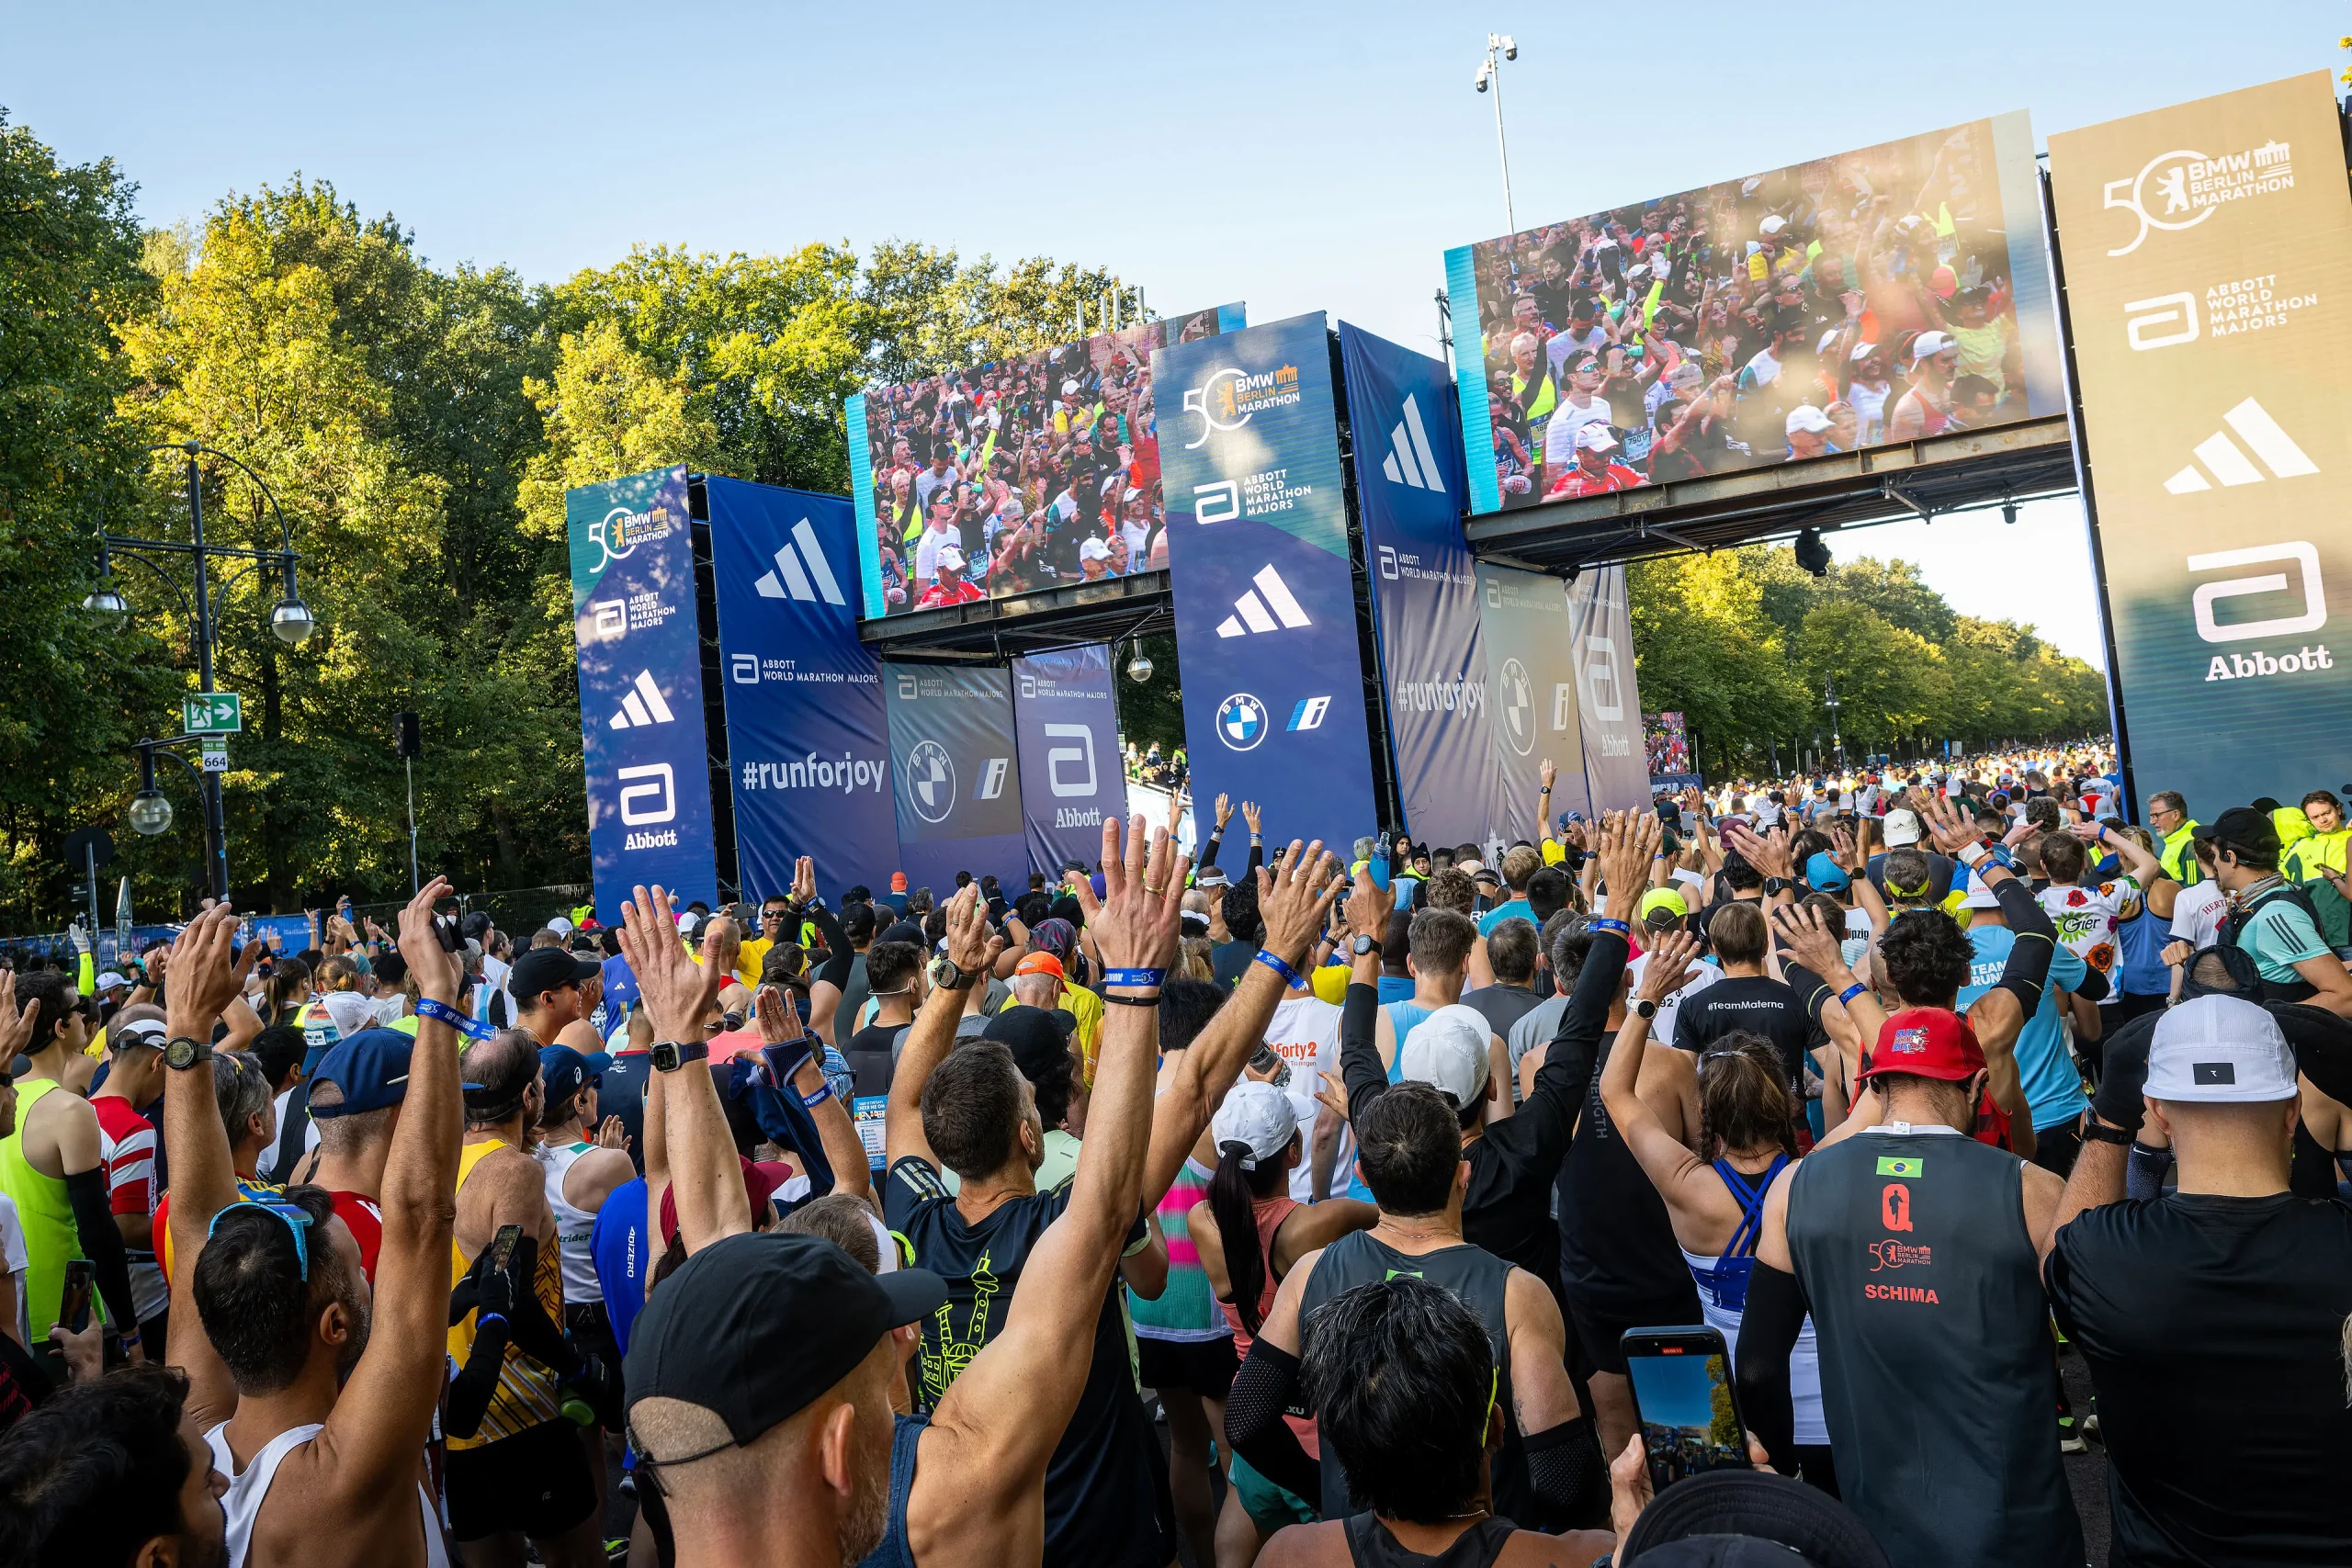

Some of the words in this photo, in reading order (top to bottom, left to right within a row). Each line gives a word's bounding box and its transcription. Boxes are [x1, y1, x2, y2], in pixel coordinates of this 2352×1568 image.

[2188, 150, 2250, 182] BMW
[2190, 170, 2255, 194] BERLIN
[2191, 175, 2294, 209] MARATHON
[2206, 274, 2277, 299] ABBOTT
[2206, 288, 2272, 310] WORLD
[2209, 293, 2318, 325] MARATHON
[2211, 312, 2288, 337] MAJORS
[1235, 371, 1274, 393] BMW
[1237, 386, 1276, 403] BERLIN
[1238, 392, 1300, 414] MARATHON
[1243, 468, 1287, 486] ABBOTT
[1244, 479, 1284, 496] WORLD
[1246, 485, 1312, 506] MARATHON
[1247, 499, 1294, 516] MAJORS
[625, 512, 651, 528] BMW
[626, 525, 652, 536] BERLIN
[626, 529, 669, 546] MARATHON
[1399, 553, 1420, 566] ABBOTT
[1400, 566, 1420, 579] WORLD
[1421, 570, 1452, 583] MARATHON
[1452, 573, 1473, 586] MAJORS
[629, 592, 659, 605] ABBOTT
[629, 602, 658, 613] WORLD
[630, 605, 676, 621] MARATHON
[631, 617, 663, 630] MAJORS
[763, 660, 796, 670] ABBOTT
[2205, 644, 2334, 682] Abbott
[763, 671, 794, 682] WORLD
[797, 672, 844, 682] MARATHON
[847, 674, 878, 683] MAJORS
[920, 679, 944, 687] ABBOTT
[1037, 680, 1057, 688] ABBOTT
[920, 689, 943, 697] WORLD
[944, 689, 978, 698] MARATHON
[979, 690, 1003, 698] MAJORS
[1037, 689, 1056, 697] WORLD
[1056, 690, 1085, 699] MARATHON
[1398, 671, 1486, 719] #runforjoy
[1222, 697, 1259, 715] BMW
[1601, 734, 1630, 757] Abbott
[204, 758, 226, 767] 664
[912, 745, 947, 768] BMW
[743, 751, 885, 795] #runforjoy
[1056, 807, 1102, 829] Abbott
[625, 829, 678, 851] Abbott
[1849, 928, 1869, 941] ipzig
[1707, 1000, 1784, 1011] #TeamMaterna
[559, 1234, 594, 1243] trider
[627, 1226, 635, 1279] ADIZERO
[1897, 1245, 1918, 1254] BMW
[1897, 1258, 1931, 1266] MARATHON
[1864, 1283, 1939, 1304] SCHIMA
